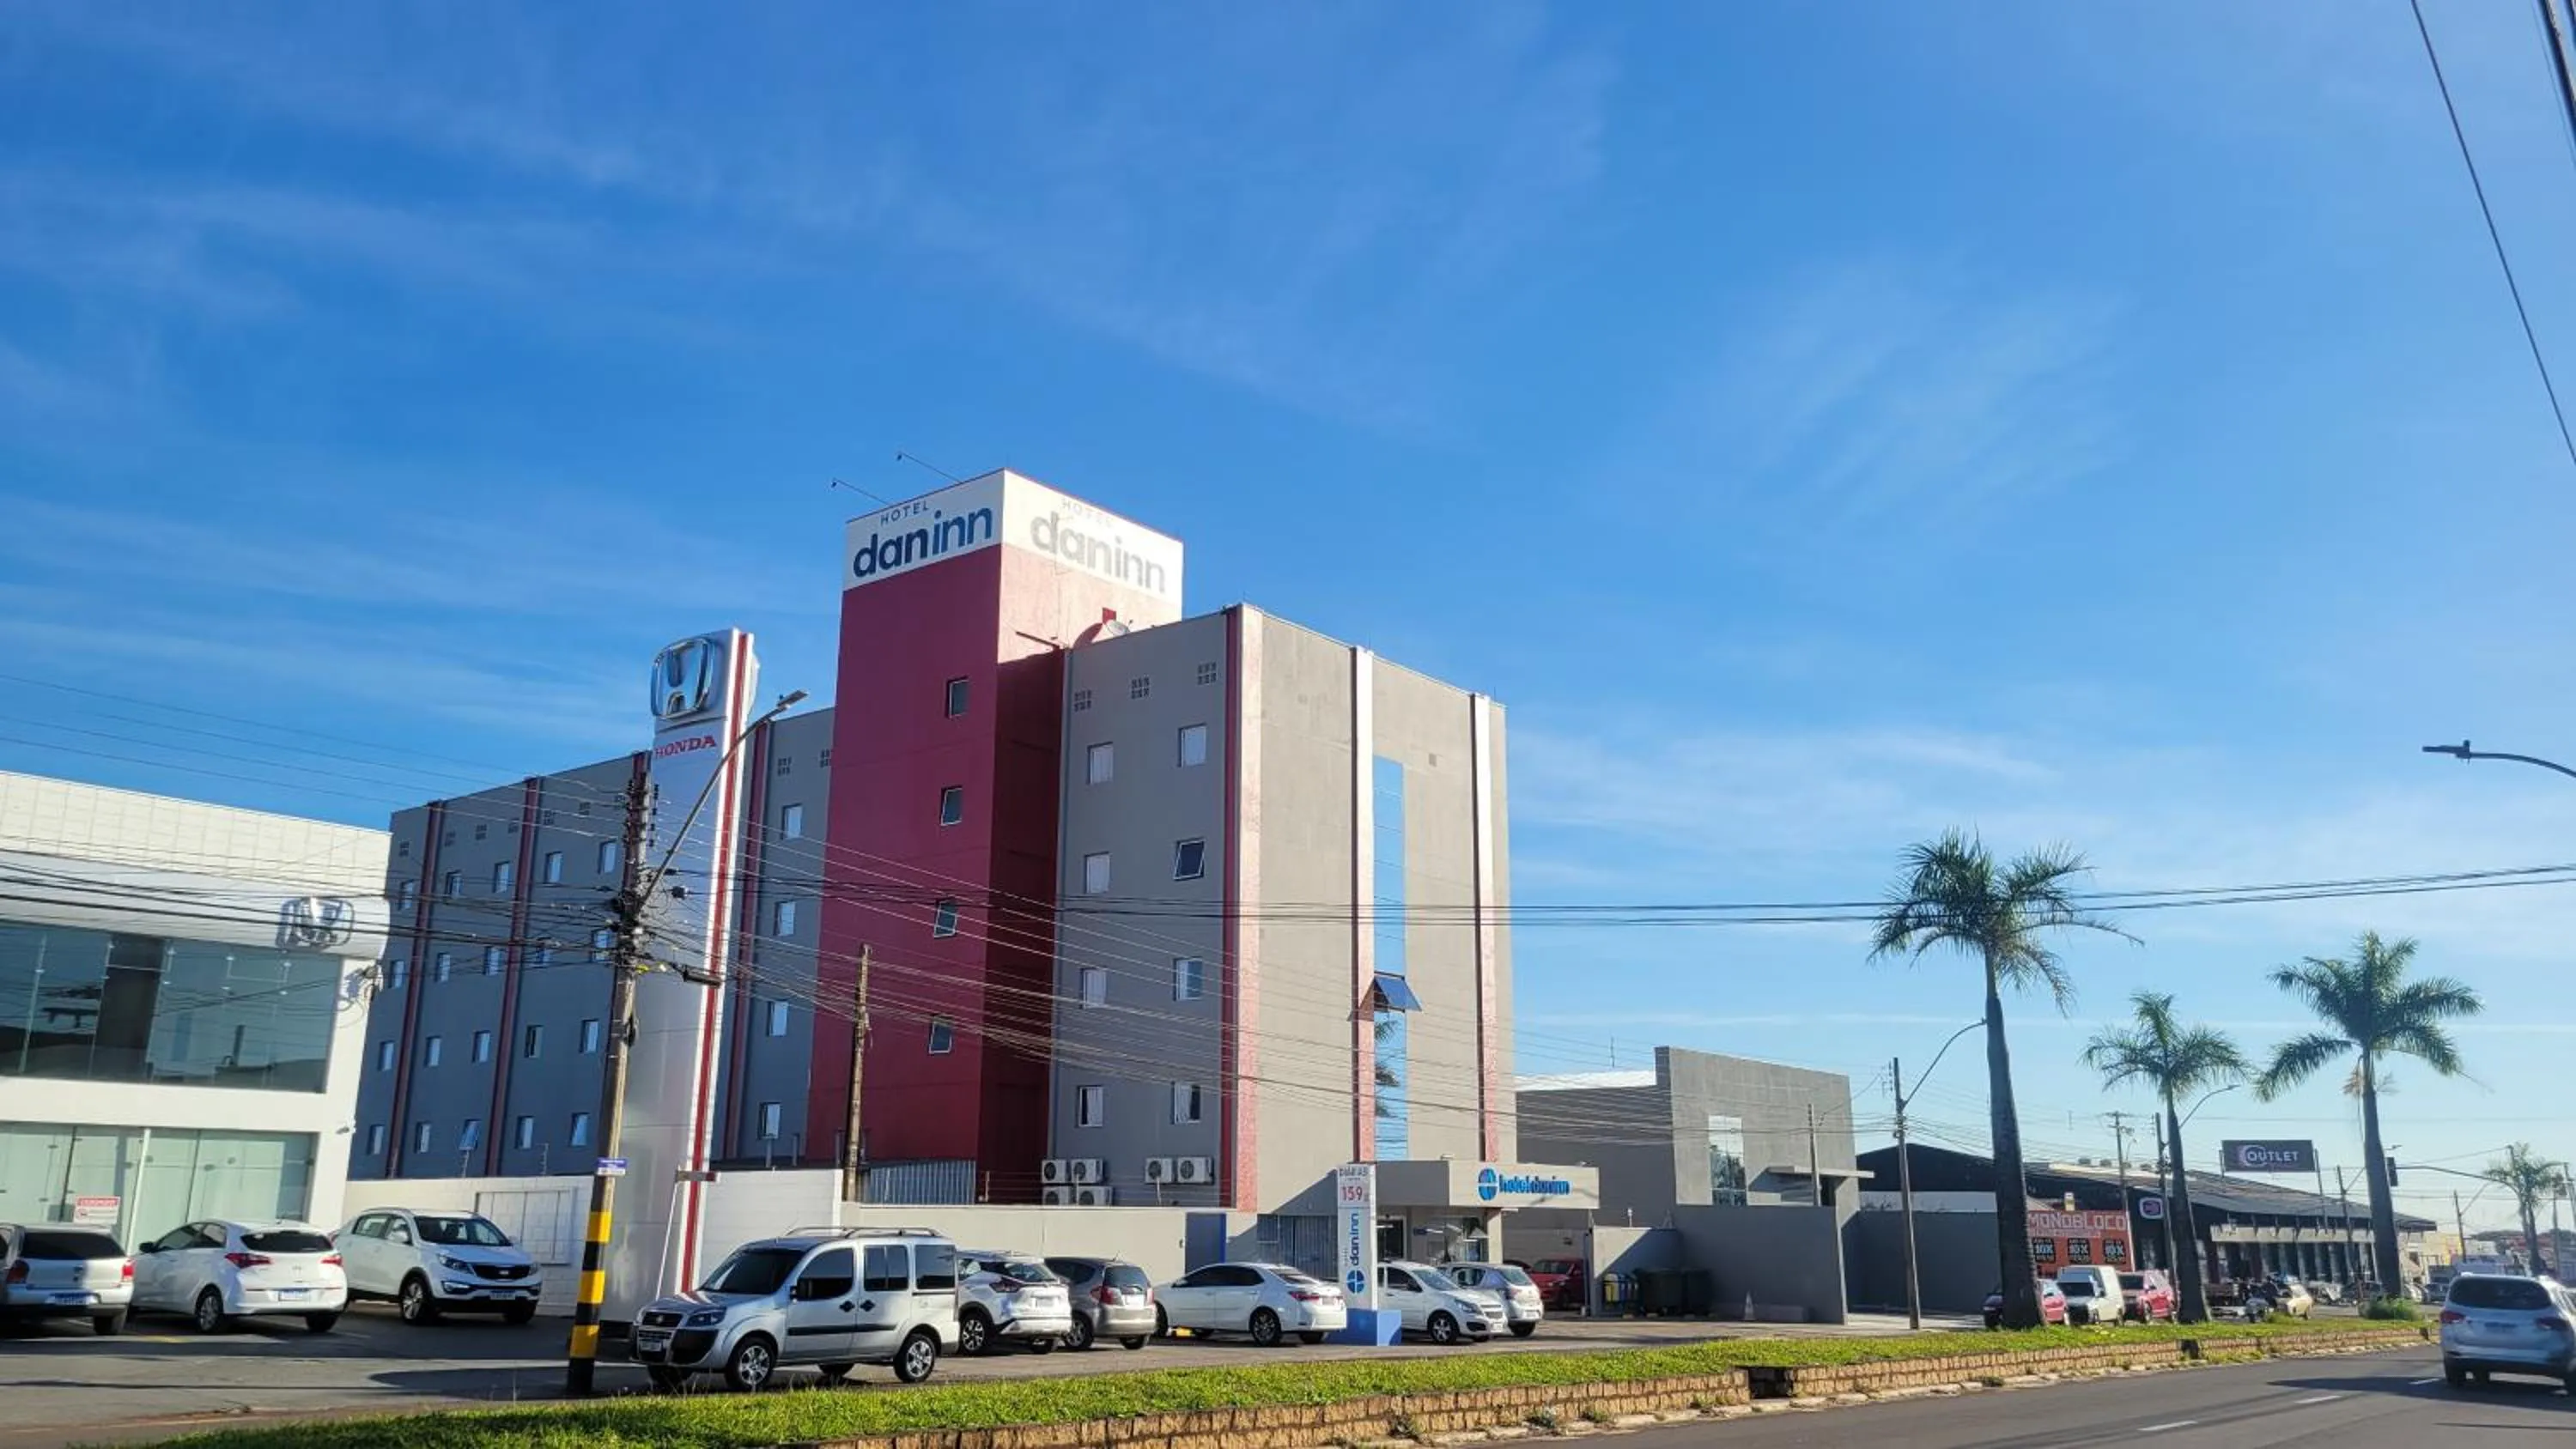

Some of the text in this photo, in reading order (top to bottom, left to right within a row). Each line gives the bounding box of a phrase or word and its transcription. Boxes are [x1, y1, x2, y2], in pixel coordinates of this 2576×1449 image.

[881, 500, 929, 526] HOTEL
[854, 508, 993, 577] daninn
[1030, 511, 1165, 594] daninn
[655, 735, 717, 757] HONDA
[2247, 1150, 2300, 1161] OUTLET
[1341, 1185, 1364, 1201] 159
[2028, 1211, 2127, 1230] MONOBLOCO
